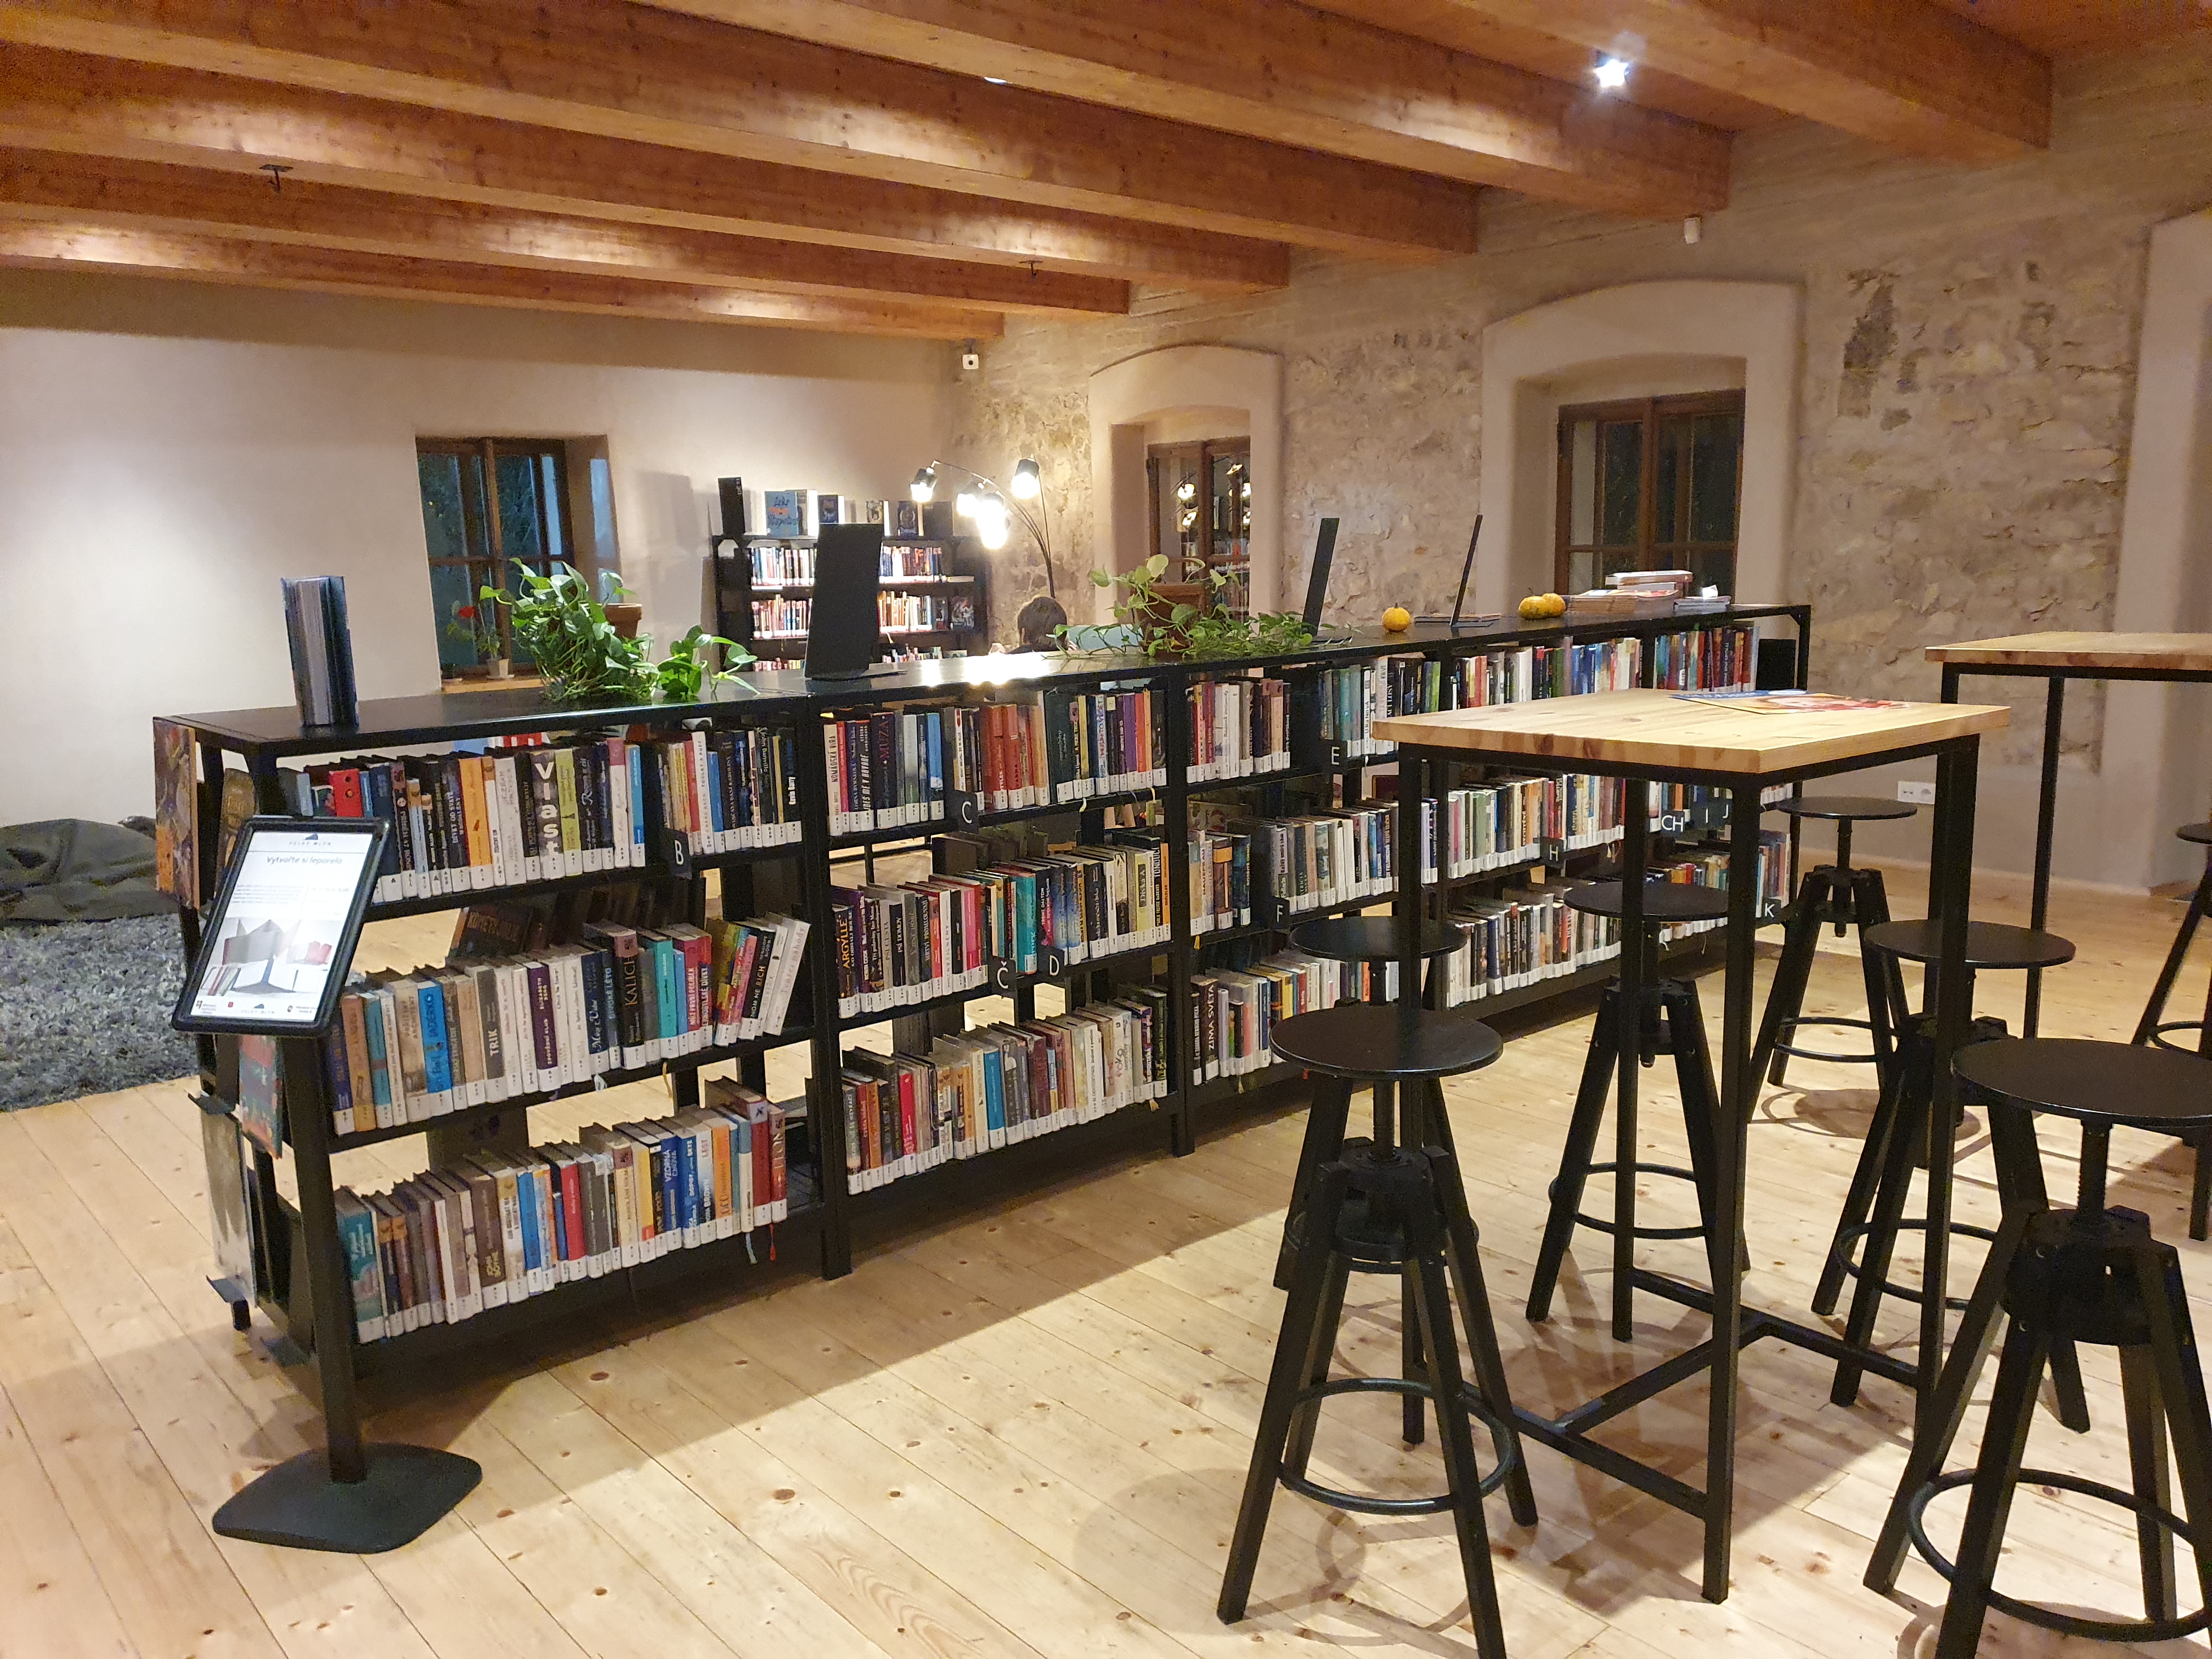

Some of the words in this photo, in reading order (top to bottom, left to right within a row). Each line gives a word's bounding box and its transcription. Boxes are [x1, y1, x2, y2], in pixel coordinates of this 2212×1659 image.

[1331, 746, 1340, 765] E
[829, 750, 839, 783] NOMÁDSKÁ
[962, 801, 972, 823] C
[1723, 805, 1729, 819] J
[1661, 815, 1683, 832] CH
[267, 856, 300, 865] Vytvořte
[310, 856, 342, 865] leporelo
[675, 840, 684, 865] B
[1549, 844, 1559, 861] H
[1277, 904, 1283, 922] F
[1764, 902, 1775, 918] K
[838, 915, 850, 969] ARGYLLE
[1049, 955, 1059, 975] D
[997, 961, 1009, 989] Č
[488, 1028, 500, 1057] TRIK
